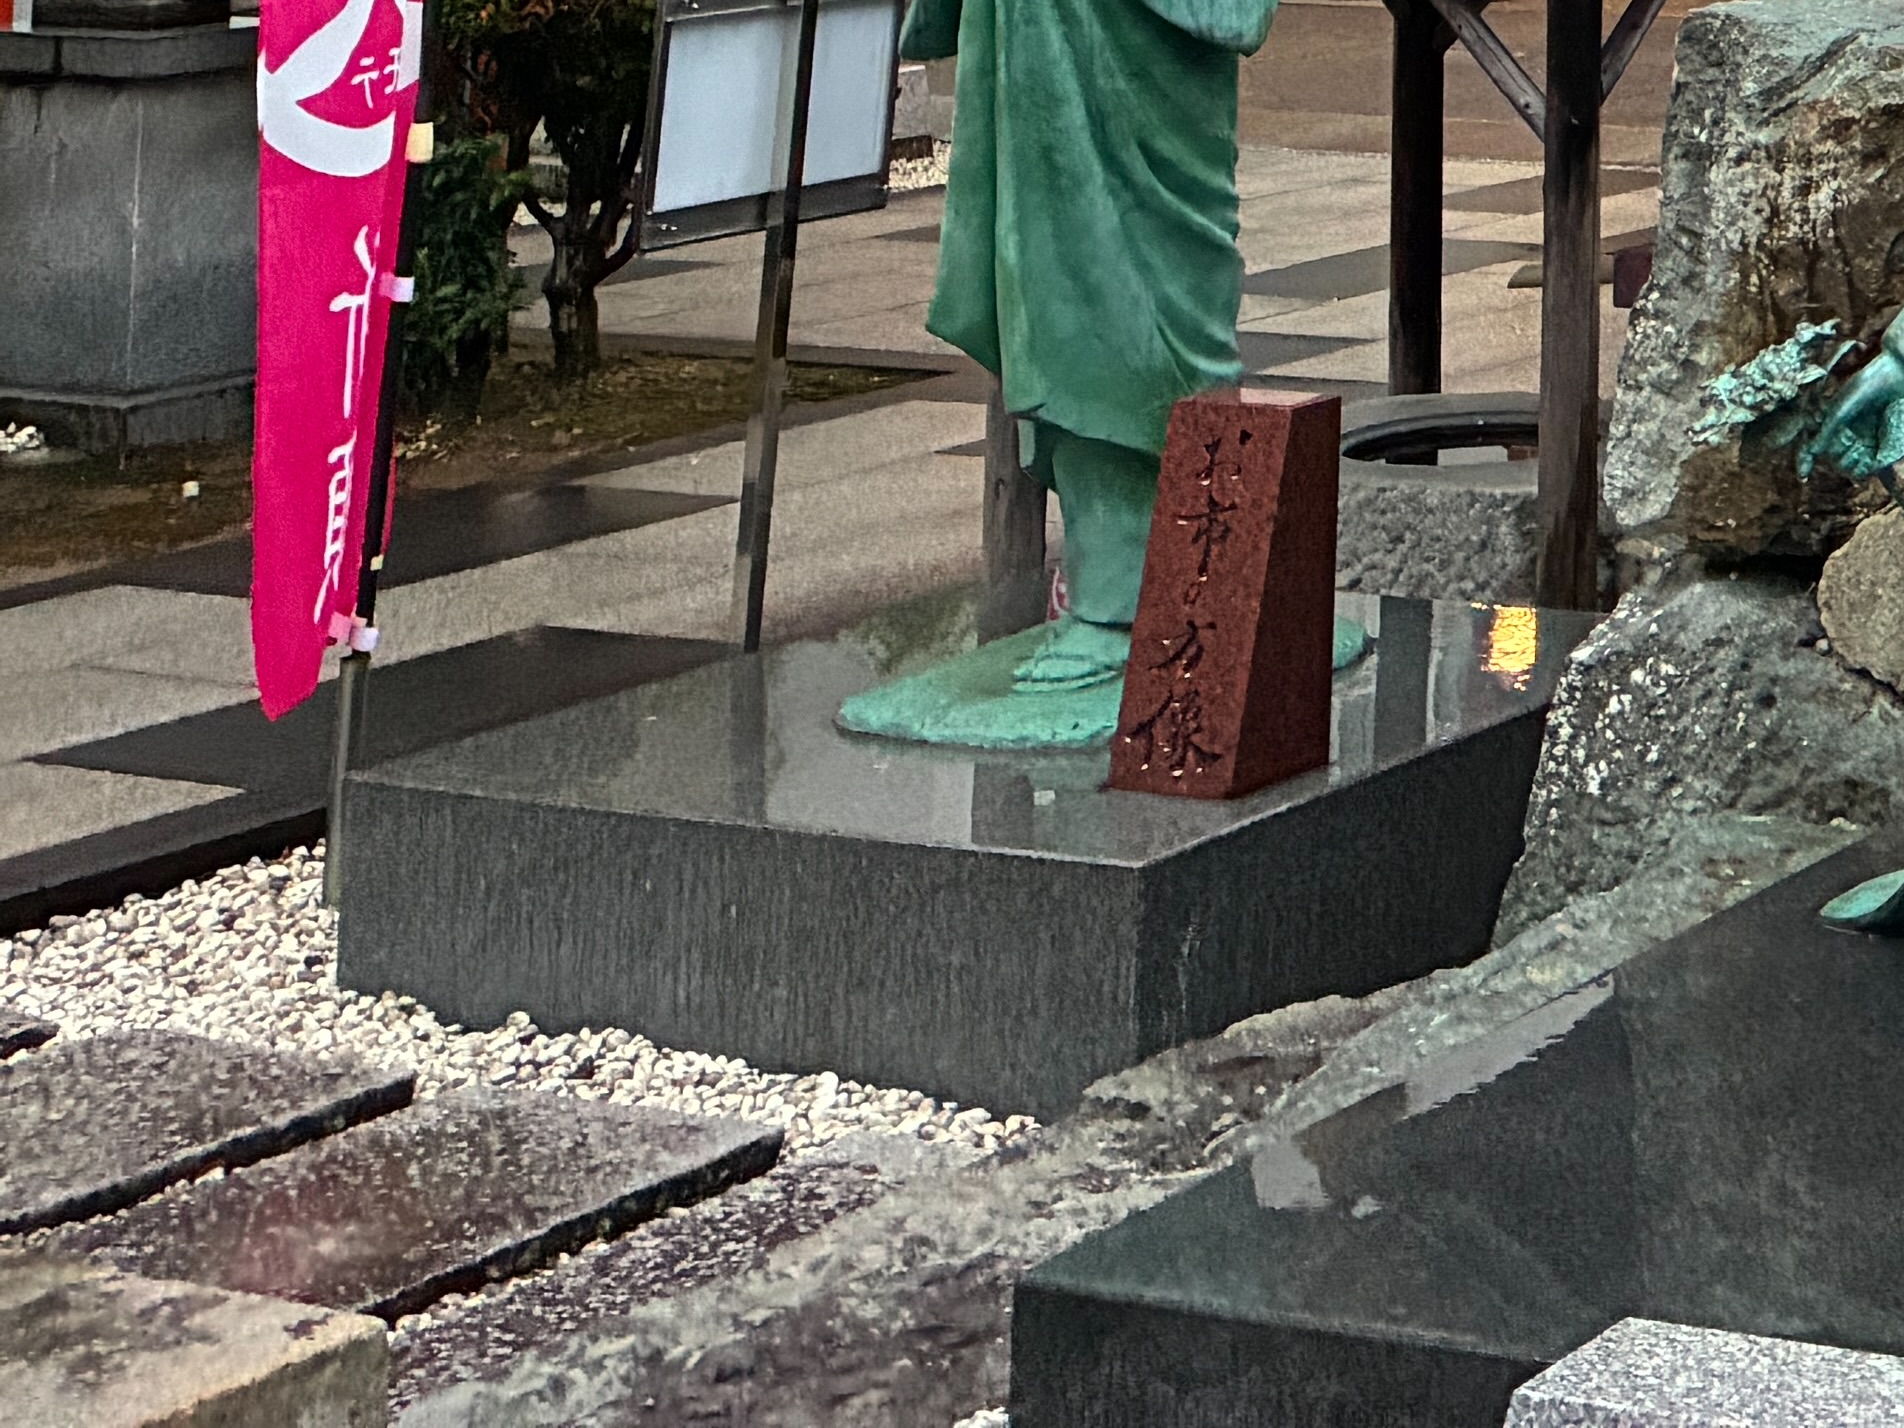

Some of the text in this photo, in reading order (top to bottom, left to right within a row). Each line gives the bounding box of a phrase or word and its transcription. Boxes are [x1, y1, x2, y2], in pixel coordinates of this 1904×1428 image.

[1124, 427, 1255, 781] お市の方像
